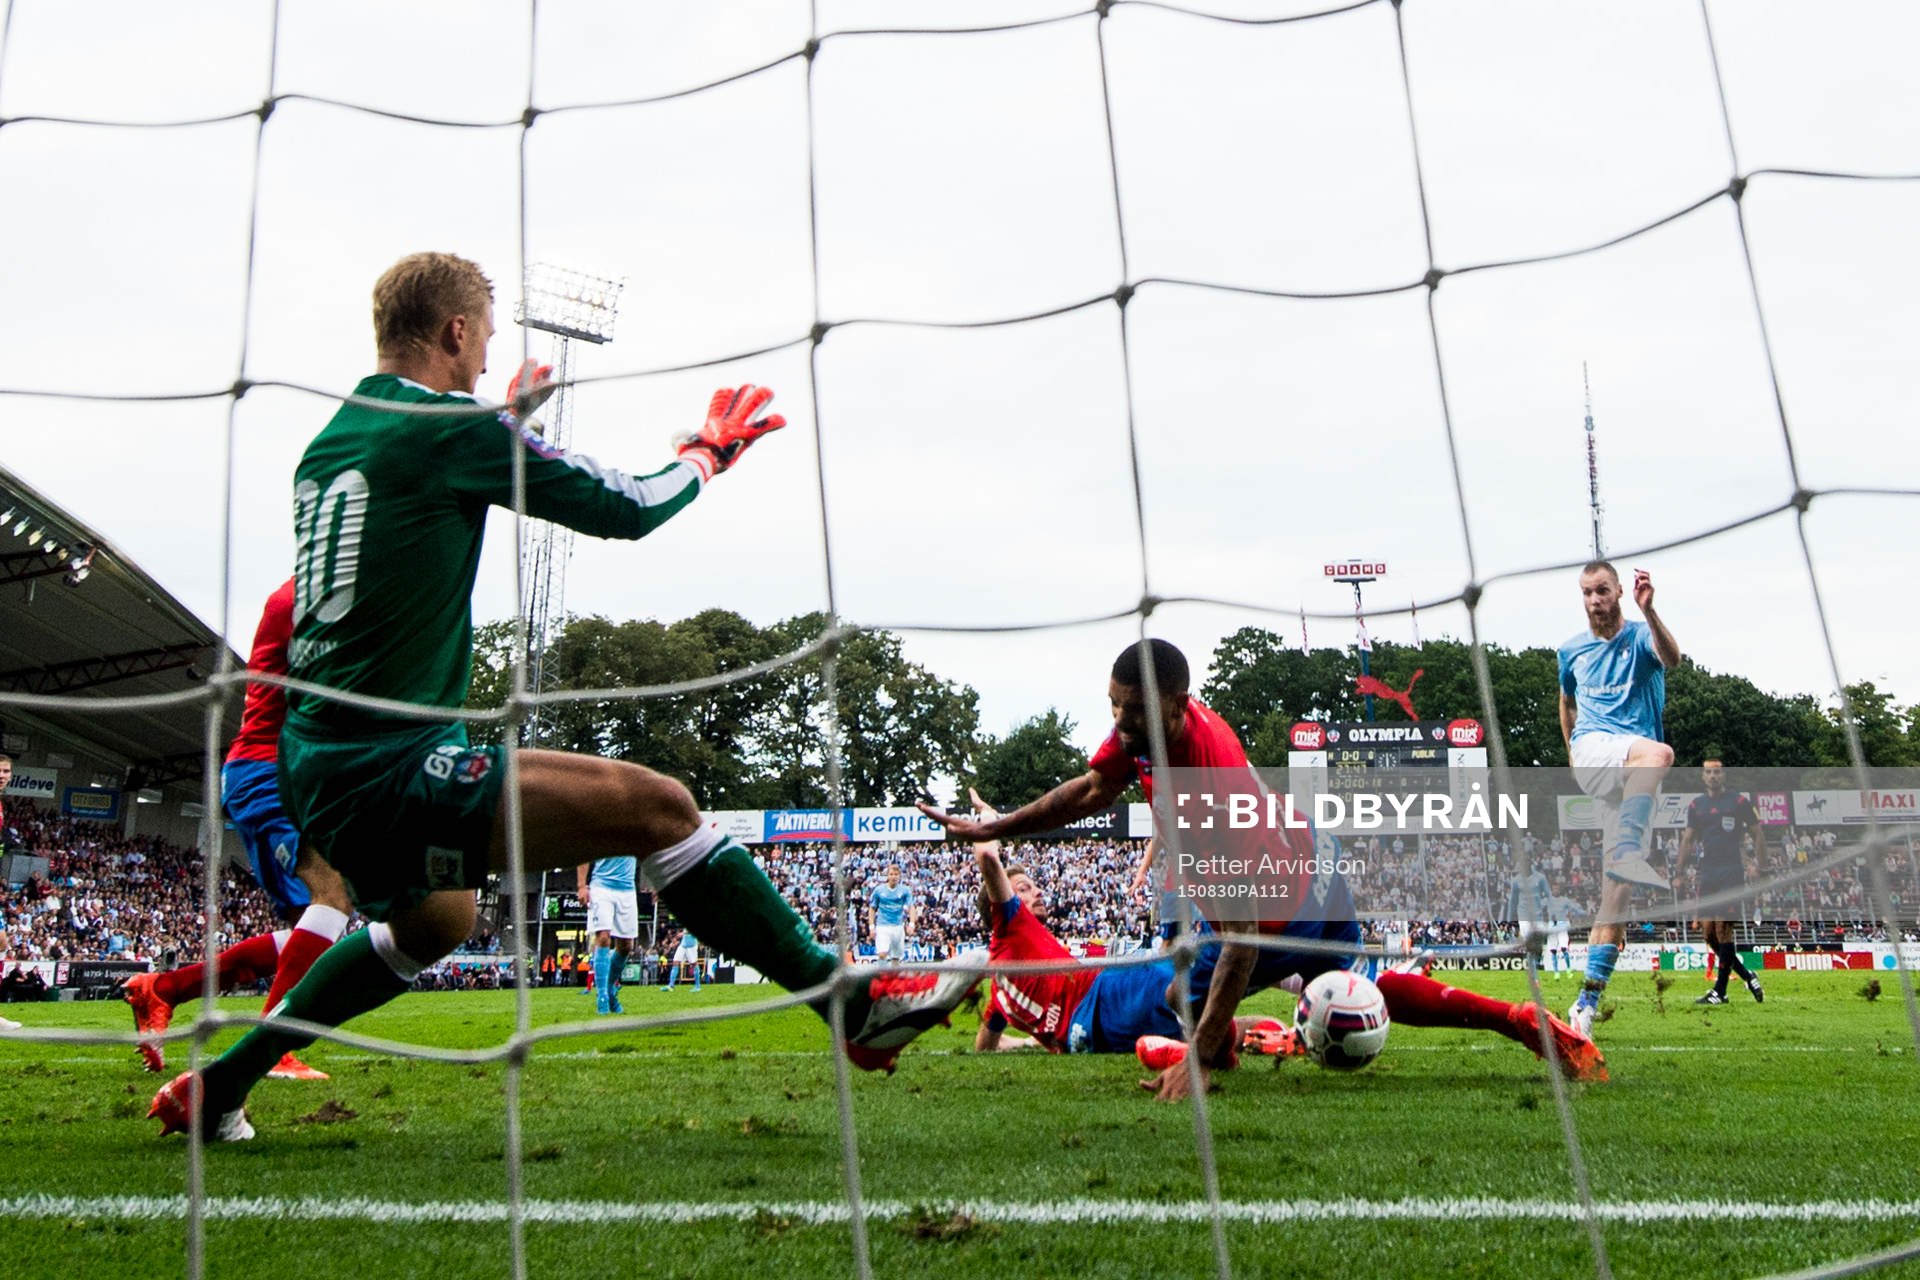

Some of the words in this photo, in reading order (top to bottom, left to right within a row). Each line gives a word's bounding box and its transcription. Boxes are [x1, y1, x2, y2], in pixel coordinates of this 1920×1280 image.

[1325, 565, 1385, 575] CRAMO
[1349, 728, 1424, 742] OLYMPIA
[7, 775, 54, 791] ildeve
[1758, 794, 1785, 810] nya
[1860, 792, 1915, 809] MAXI
[1785, 953, 1833, 970] PUMA
